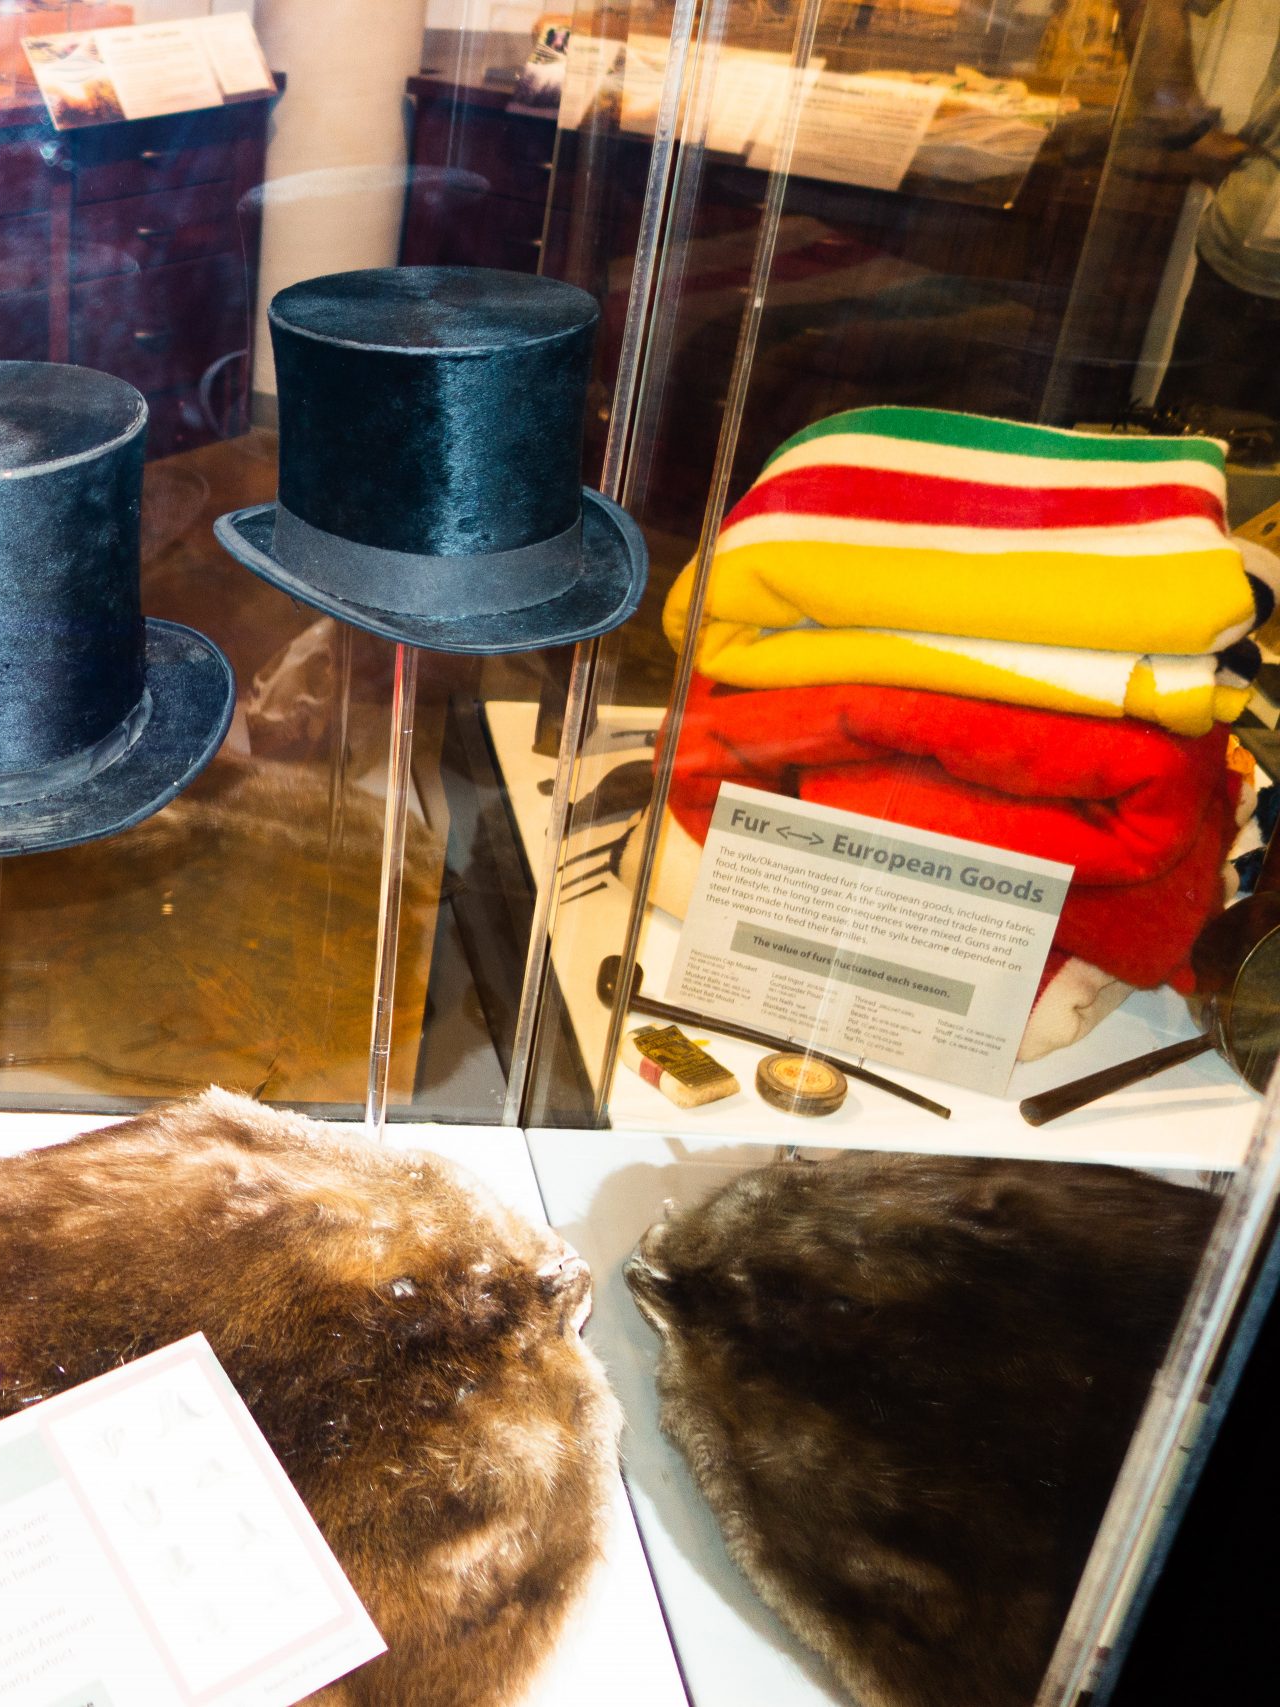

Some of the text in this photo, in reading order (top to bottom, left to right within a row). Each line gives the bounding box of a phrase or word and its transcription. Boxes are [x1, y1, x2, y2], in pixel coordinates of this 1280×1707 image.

[730, 808, 1044, 903] Fur European Goods
[719, 845, 1035, 936] The syilx/Okanagan traded furs for European goods, including fabric,
[715, 856, 1029, 947] food, tools and hunting gear. As the syilx integrated trade items into
[705, 893, 868, 944] these weapons to feed their families.
[712, 869, 1012, 956] their lifestyle, the long term consequences were mixed. Guns and
[709, 882, 1022, 972] steel traps made hunting easier, but the syilx became dependent on
[721, 958, 735, 967] Cap
[735, 961, 757, 972] Musket
[753, 935, 950, 998] The value of furs fluctuated each season.
[684, 970, 706, 980] Musket
[771, 972, 787, 981] Lead
[680, 983, 702, 994] Musket
[714, 993, 735, 1003] Mould
[768, 979, 806, 995] Gunpowder
[762, 1001, 788, 1013] Blankets
[778, 997, 794, 1006] Nails
[854, 995, 876, 1006] Thread
[847, 1017, 859, 1025] Pot
[849, 1008, 869, 1019] Beads
[845, 1025, 862, 1034] Knife
[934, 1026, 952, 1036] Snuff
[936, 1018, 964, 1031] Tobacco
[842, 1033, 854, 1041] Tea
[931, 1035, 947, 1045] Pipe
[20, 1513, 50, 1532] were
[1, 1543, 26, 1563] The
[25, 1530, 55, 1552] hats
[11, 1550, 60, 1581] beavers
[14, 1624, 31, 1637] as
[40, 1606, 67, 1624] new
[35, 1612, 96, 1649] American
